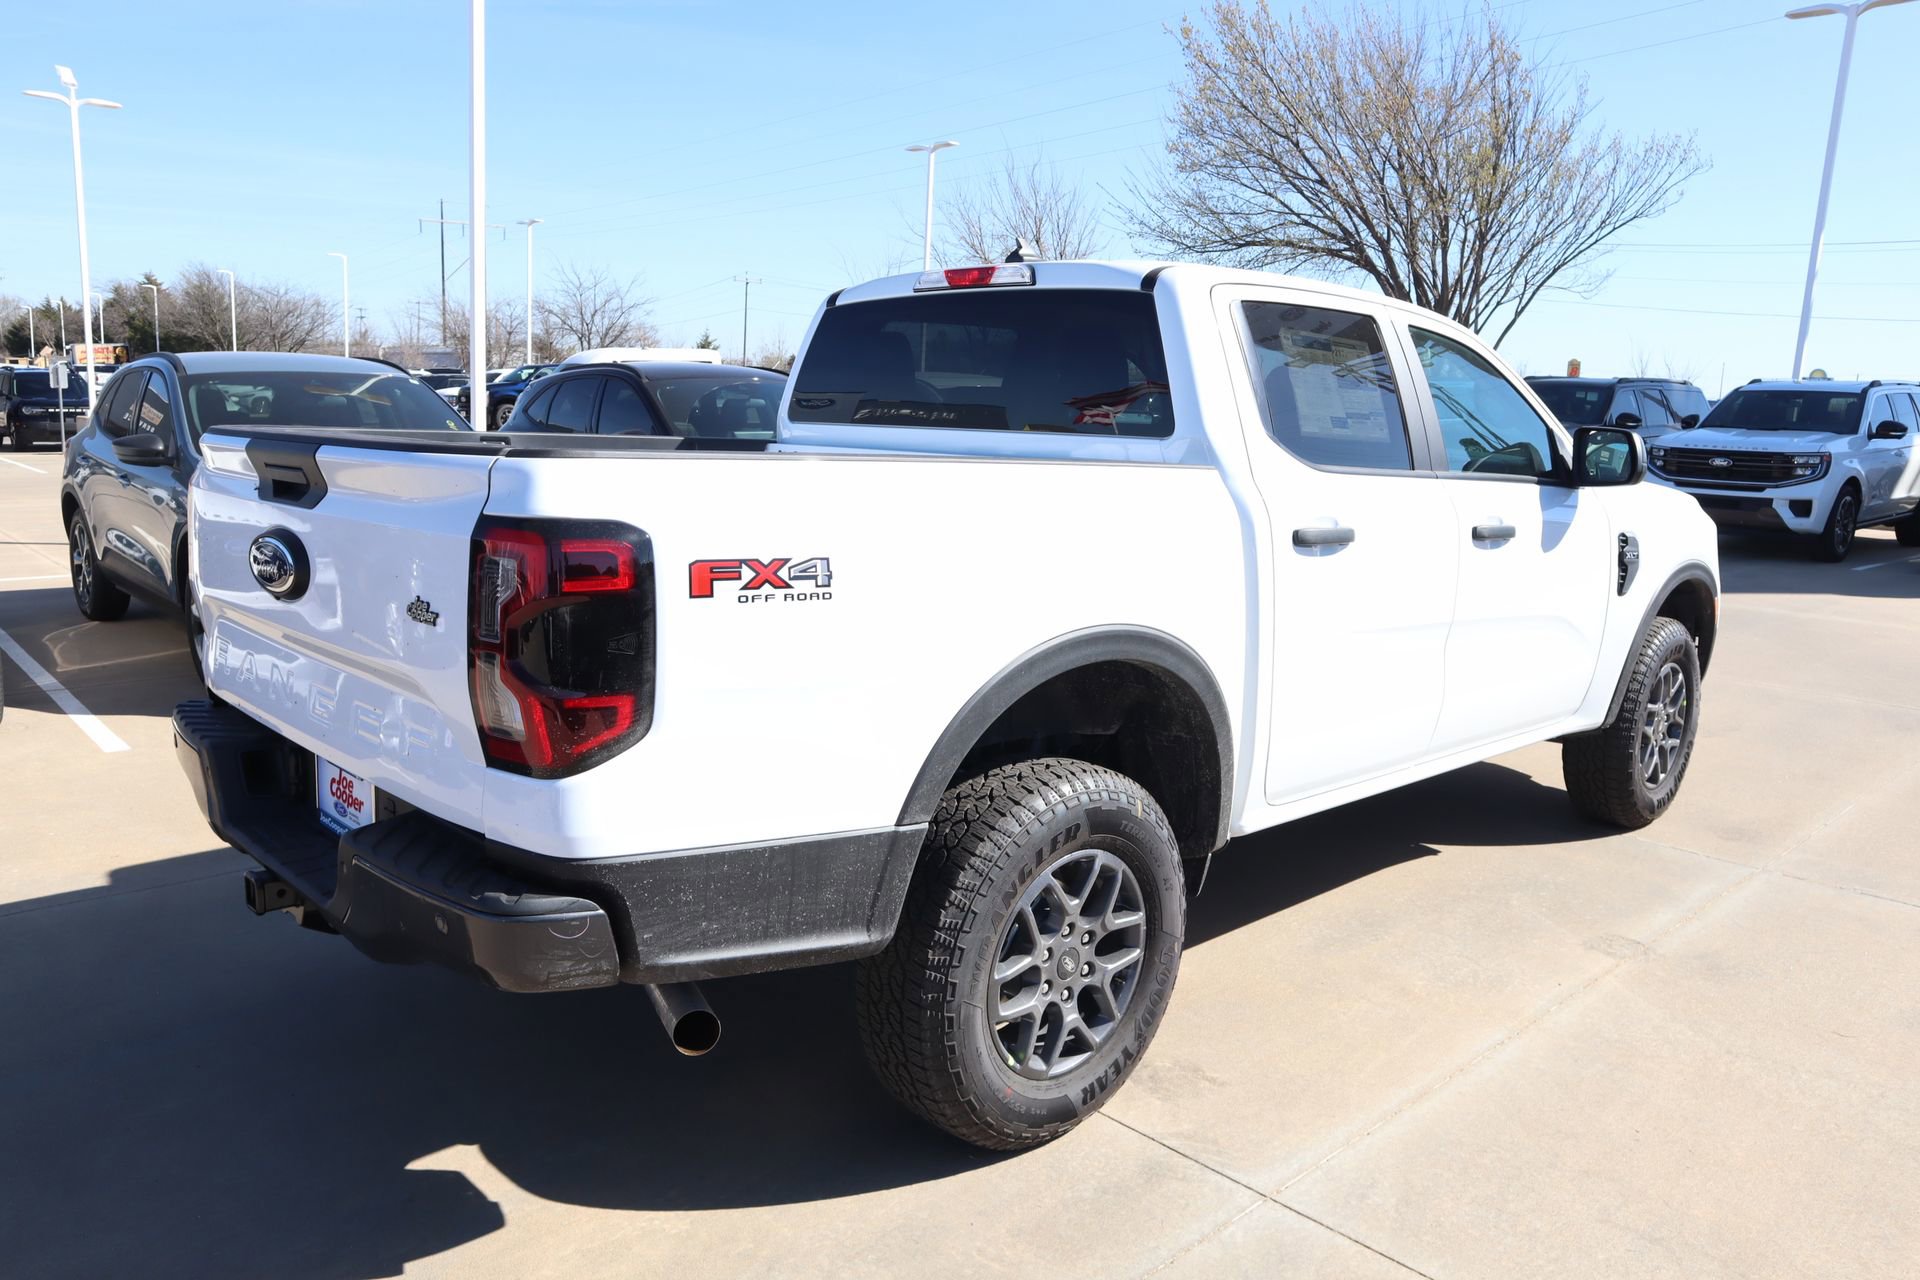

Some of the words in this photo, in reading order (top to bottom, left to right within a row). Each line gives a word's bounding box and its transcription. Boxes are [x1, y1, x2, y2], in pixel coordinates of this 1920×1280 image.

[1625, 551, 1639, 559] XLT
[689, 557, 832, 598] FX4
[411, 595, 430, 612] Joe
[738, 594, 776, 603] OFF
[784, 592, 832, 601] ROAD
[407, 603, 438, 626] Cooper
[337, 768, 354, 793] Joe
[330, 777, 364, 813] Cooper
[1080, 943, 1176, 1108] GOODYEAR
